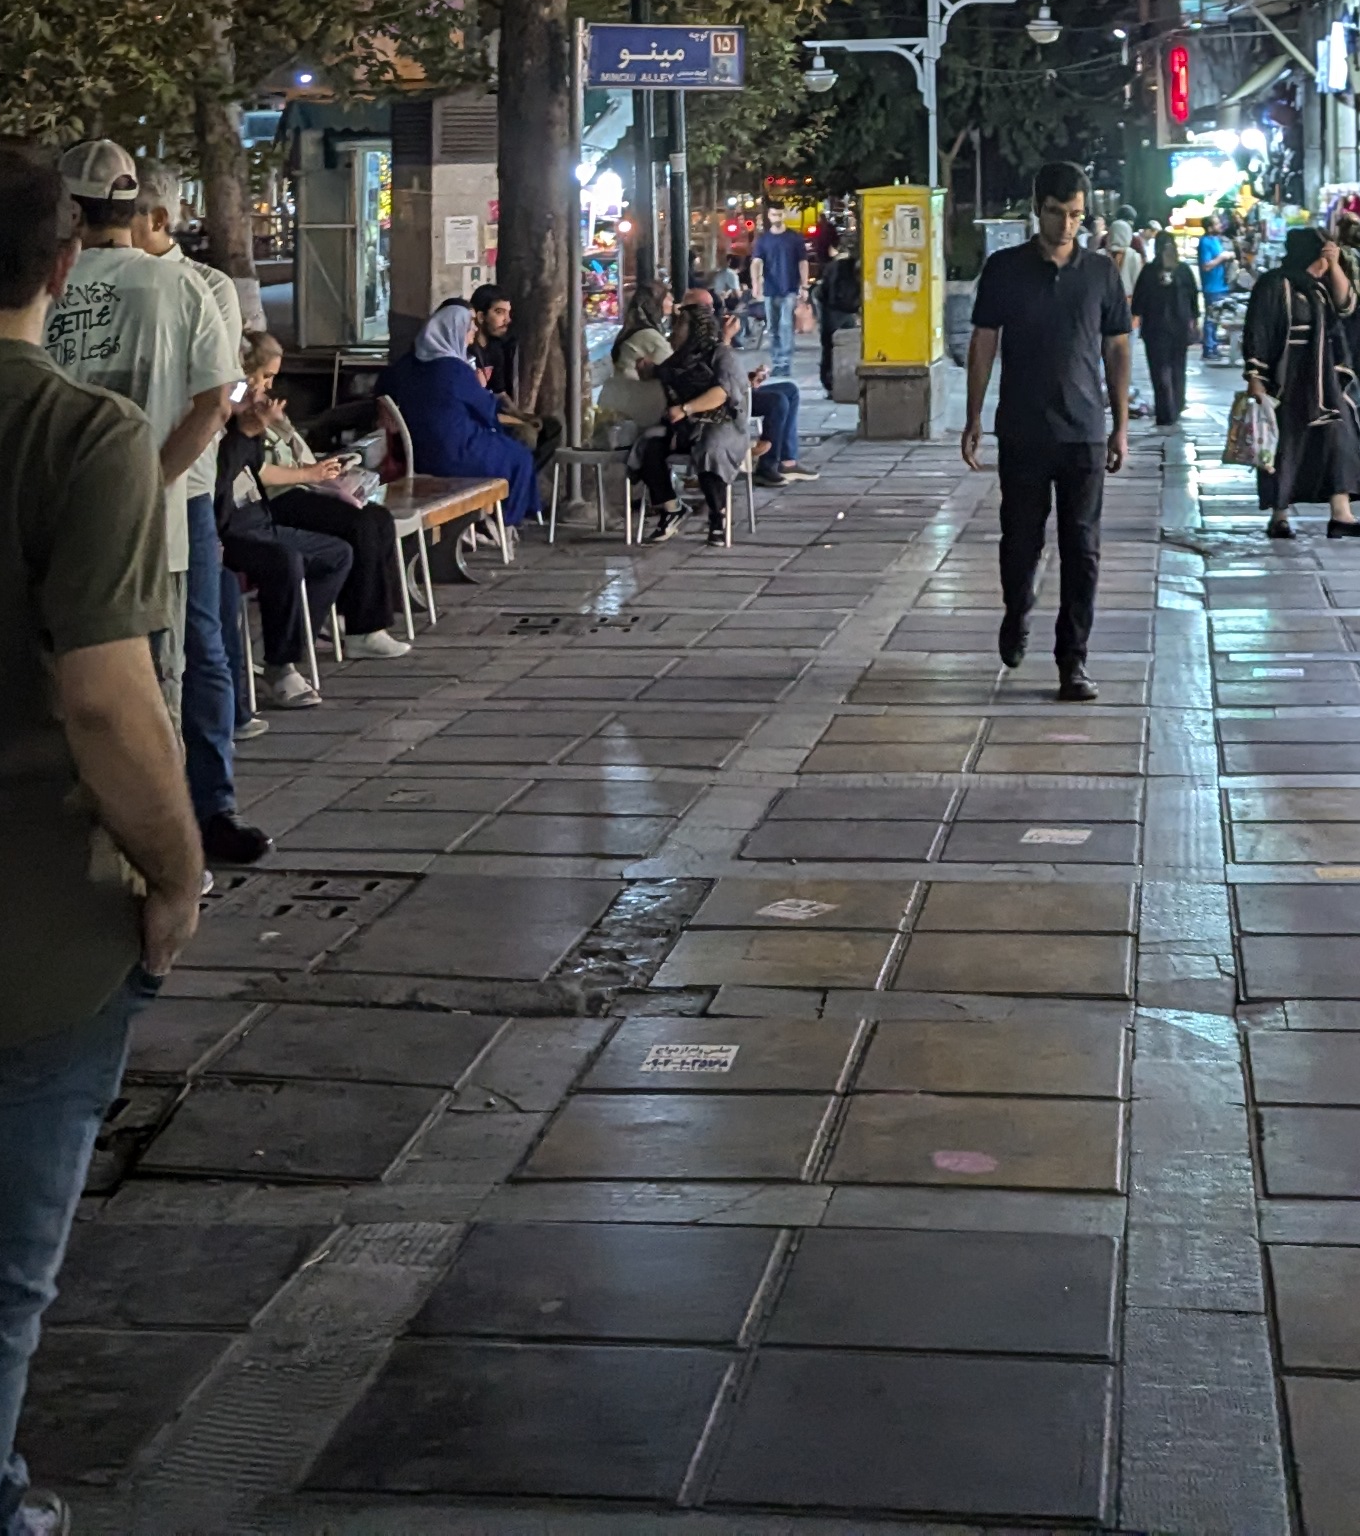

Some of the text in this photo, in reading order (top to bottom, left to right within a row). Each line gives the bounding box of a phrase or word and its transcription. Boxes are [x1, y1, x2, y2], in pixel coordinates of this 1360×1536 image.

[689, 31, 710, 42] کوچه
[717, 36, 731, 52] ۱۵
[618, 42, 685, 69] مینو
[641, 73, 674, 83] ALLEY
[48, 305, 111, 343] SETTLE
